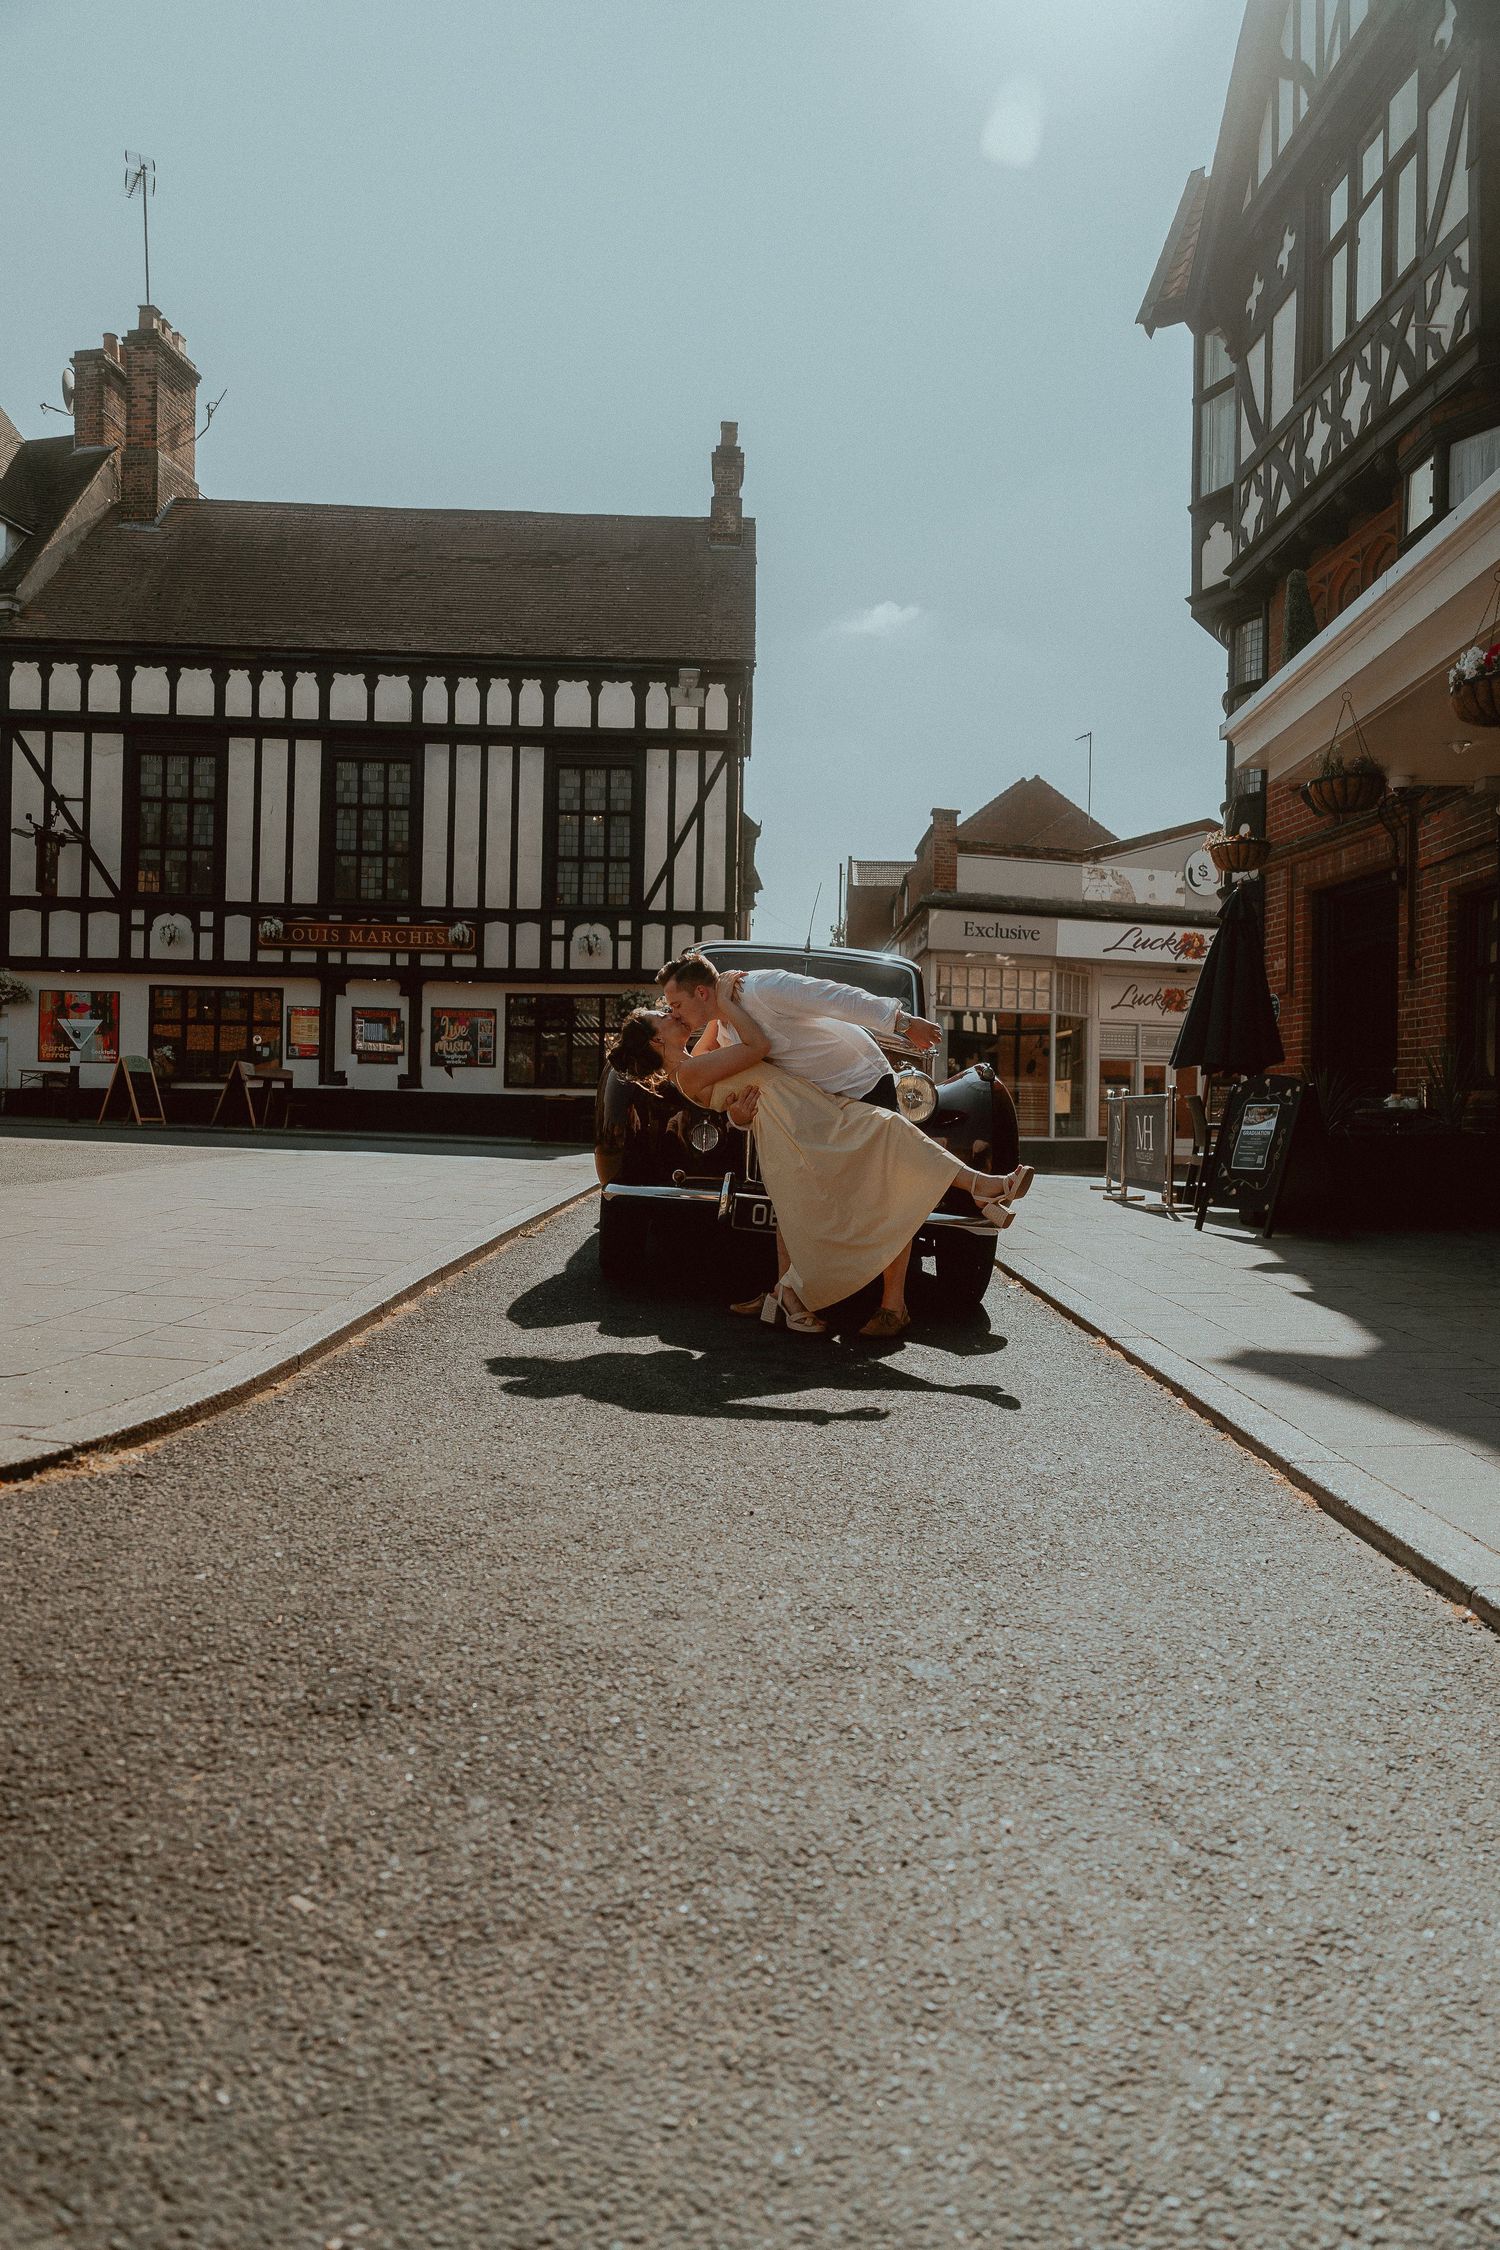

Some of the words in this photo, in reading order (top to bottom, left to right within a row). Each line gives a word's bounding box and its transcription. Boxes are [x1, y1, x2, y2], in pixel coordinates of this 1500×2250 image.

[348, 930, 452, 945] MARCHES
[963, 921, 1040, 941] Exclusive
[1103, 927, 1191, 961] Lucky
[1111, 984, 1172, 1016] Lucky
[440, 1015, 469, 1040] Live
[1135, 1115, 1154, 1150] MH
